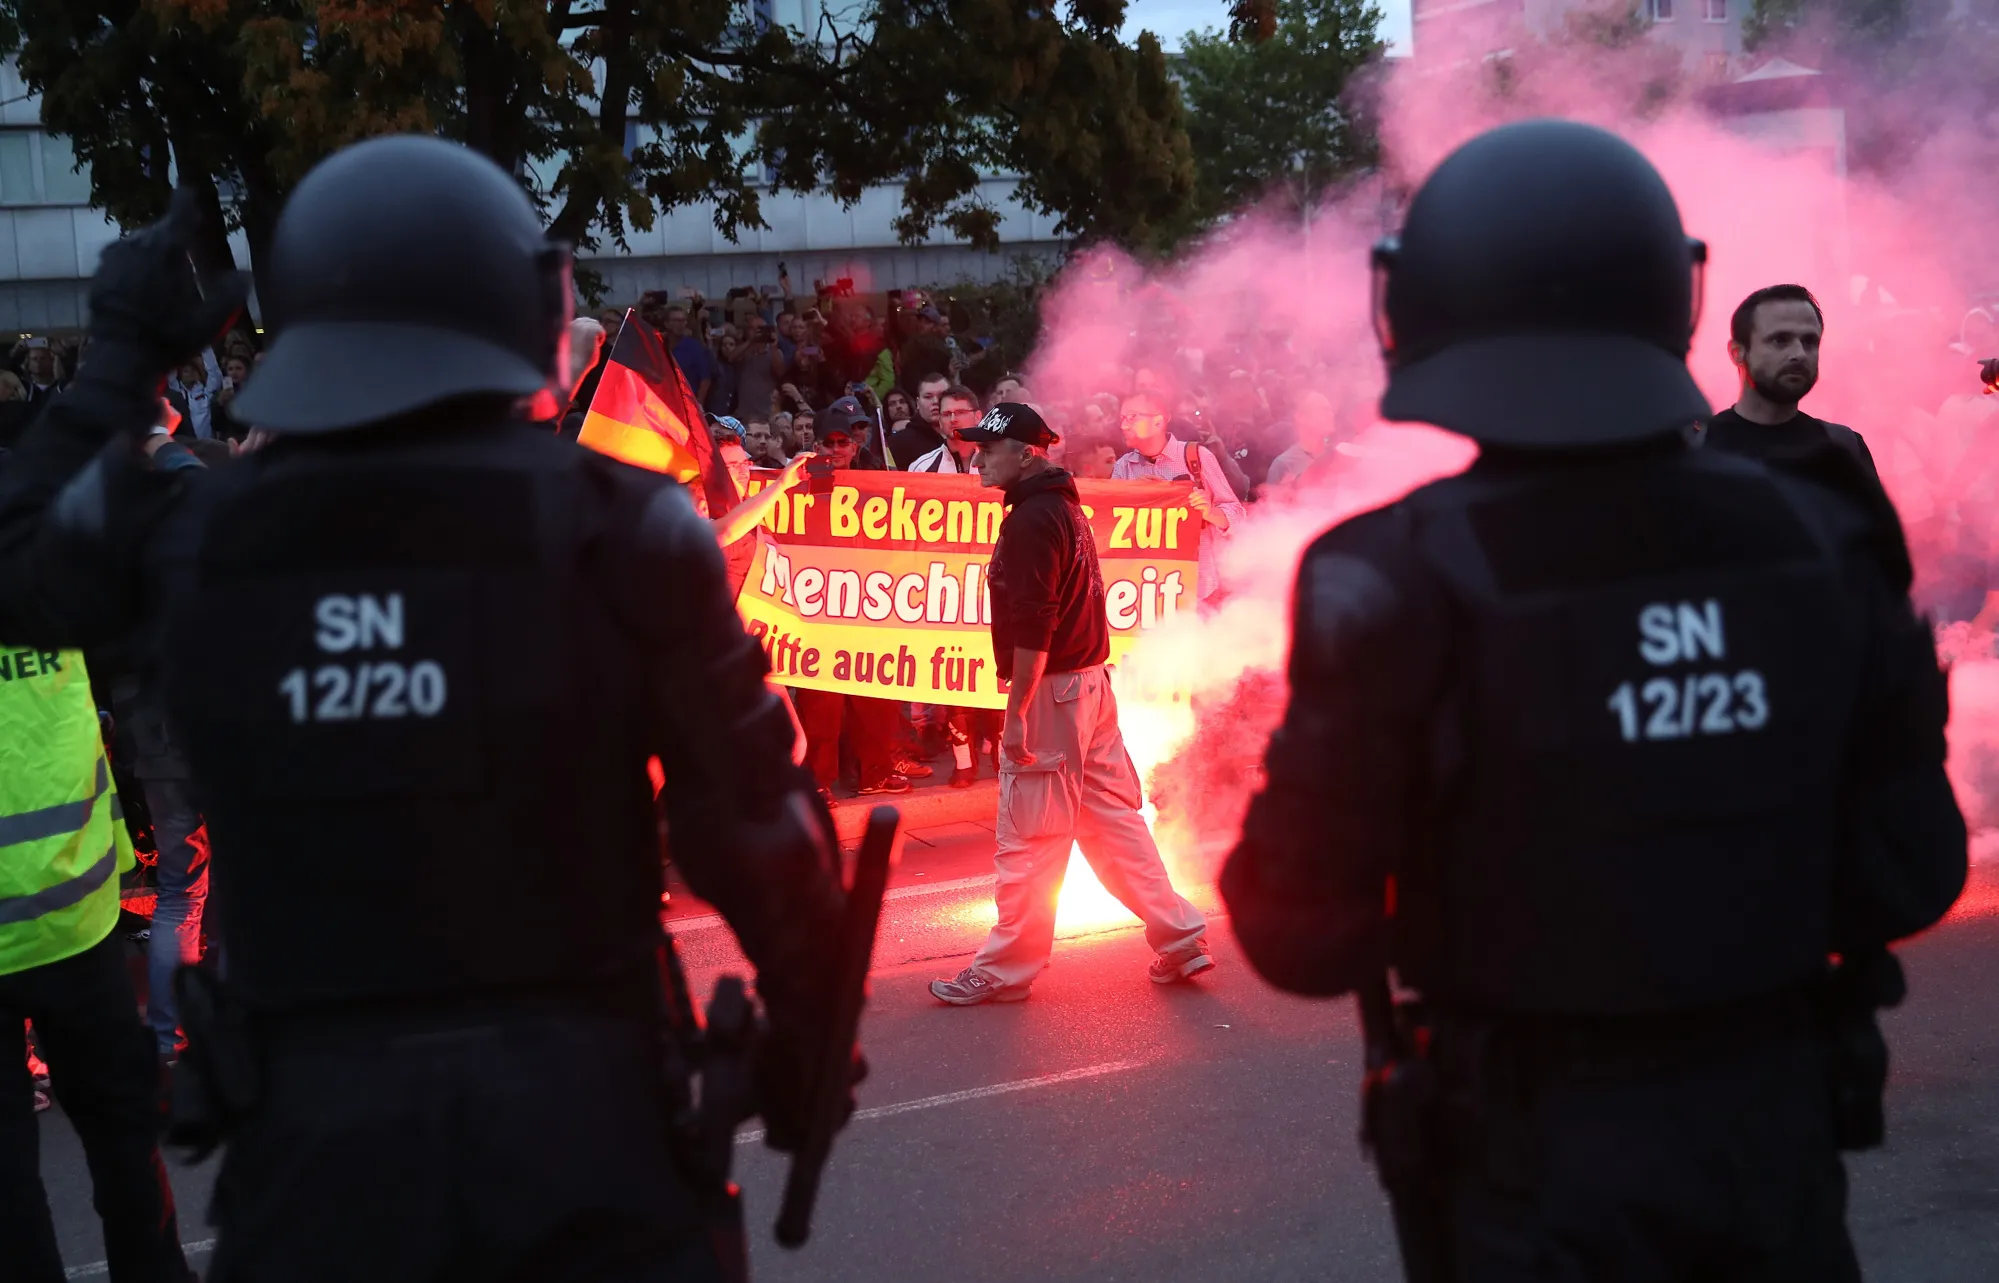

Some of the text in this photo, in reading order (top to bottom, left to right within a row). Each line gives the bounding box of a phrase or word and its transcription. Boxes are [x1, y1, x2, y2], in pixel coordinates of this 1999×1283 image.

[830, 486, 1095, 545] Bekenn
[1109, 506, 1189, 550] zur
[761, 542, 1185, 632] Menschlieit
[316, 594, 404, 652] SN
[1639, 599, 1725, 665] SN
[280, 661, 446, 721] 12/20
[833, 644, 917, 687] auch
[930, 646, 984, 692] für
[1609, 670, 1769, 741] 12/23
